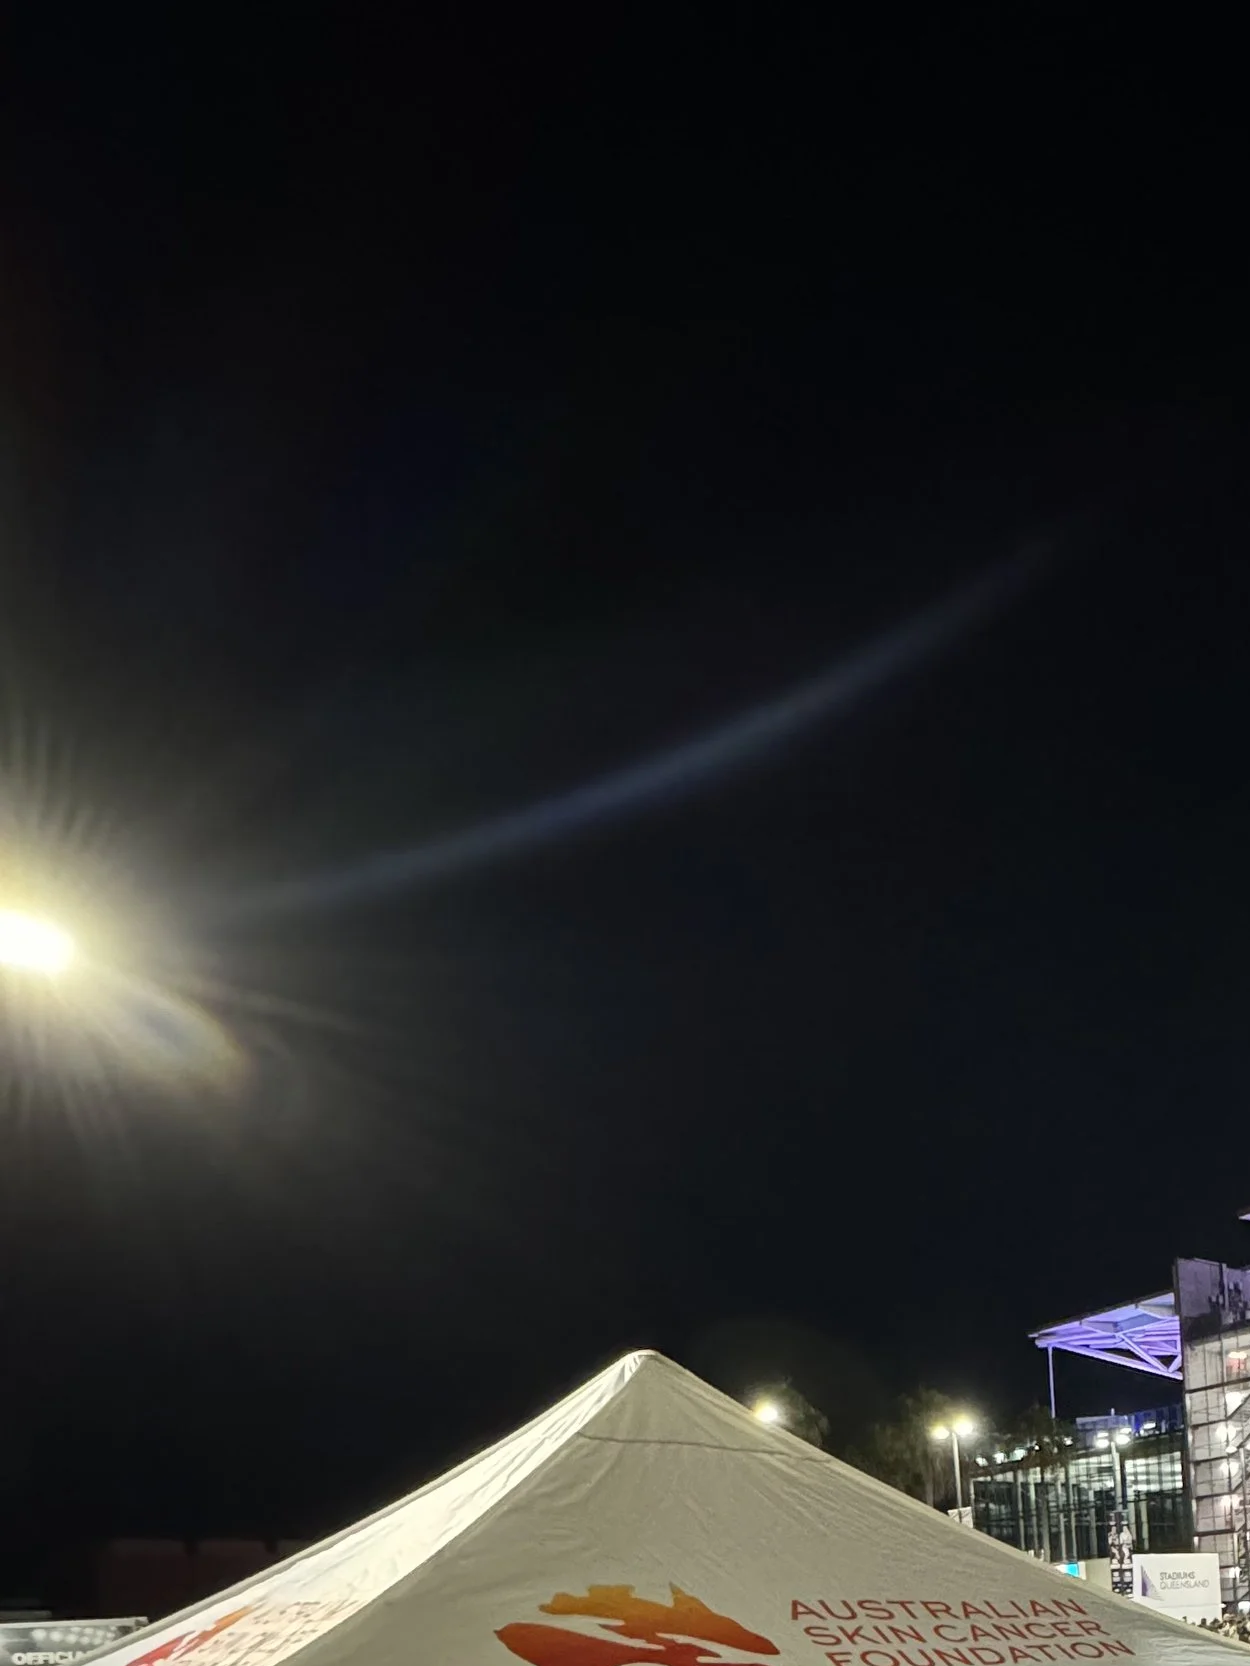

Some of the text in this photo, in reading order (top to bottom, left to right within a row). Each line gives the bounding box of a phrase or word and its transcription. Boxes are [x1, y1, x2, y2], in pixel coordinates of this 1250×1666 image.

[791, 1599, 1090, 1621] AUSTRALIAN
[803, 1620, 1111, 1646] SKIN CANCER
